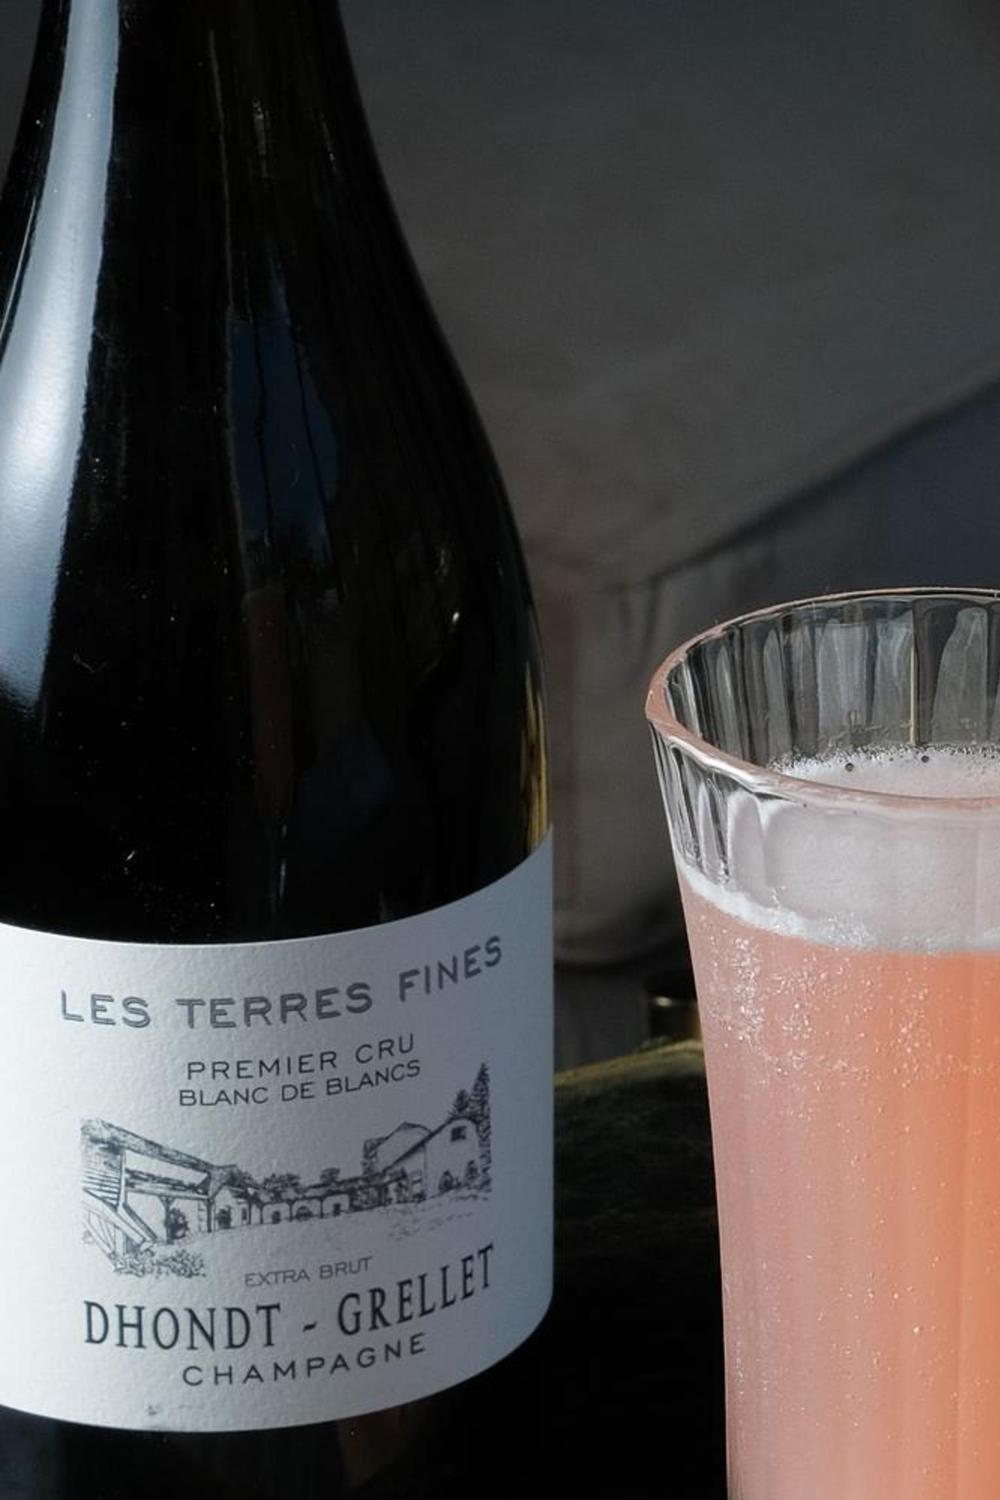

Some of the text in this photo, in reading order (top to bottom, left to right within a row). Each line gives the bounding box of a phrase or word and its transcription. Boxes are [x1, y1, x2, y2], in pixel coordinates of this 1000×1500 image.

[60, 935, 503, 1030] LES TERRES FINES
[186, 1033, 415, 1081] PREMIER CRU
[178, 1059, 422, 1107] BLANC DE BLANCS
[243, 1255, 373, 1288] EXTRA BRUT
[83, 1299, 282, 1352] DHONDT
[336, 1243, 495, 1337] GRELLET
[181, 1332, 427, 1387] CHAMPAGNE
